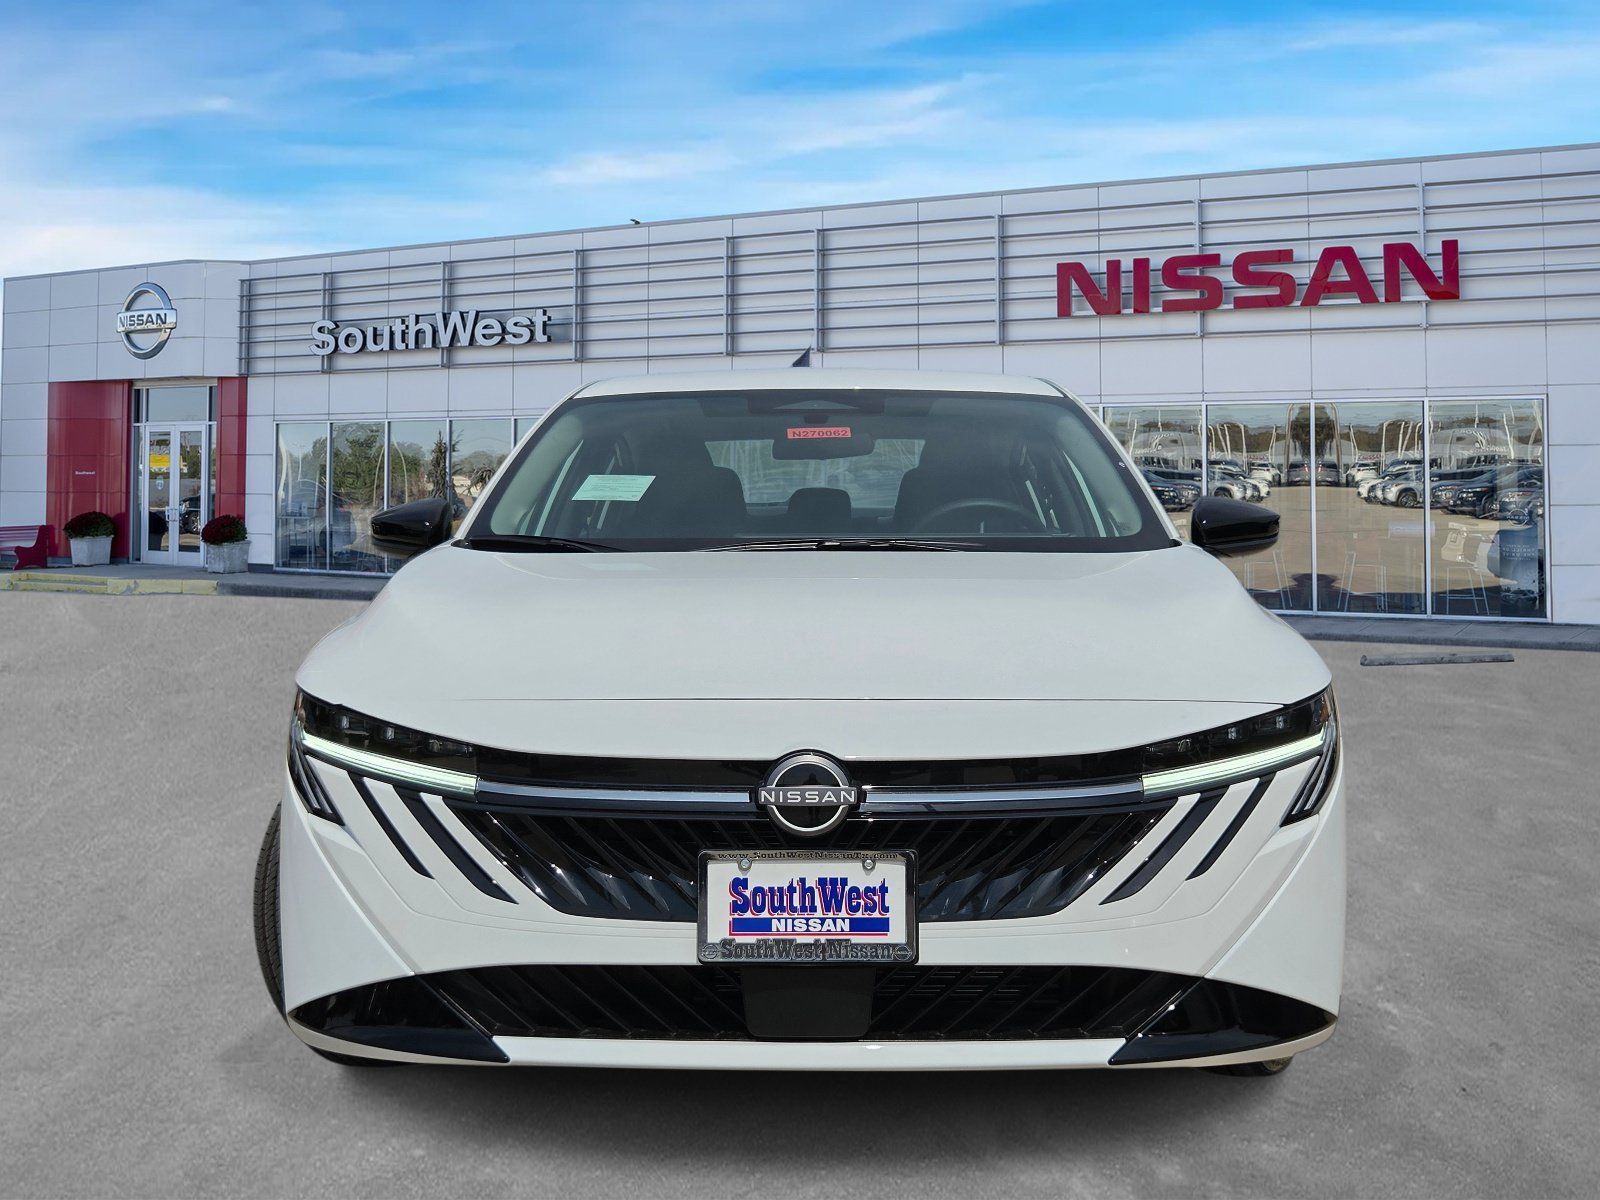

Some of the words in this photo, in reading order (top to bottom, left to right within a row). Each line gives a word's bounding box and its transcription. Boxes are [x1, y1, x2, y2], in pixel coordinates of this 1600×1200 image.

[1056, 239, 1460, 317] NISSAN
[119, 312, 167, 328] NISSAN
[308, 308, 551, 356] SouthWest
[792, 429, 849, 438] N270062
[760, 790, 855, 803] NISSAN
[728, 877, 890, 916] SouthWest
[771, 918, 850, 932] NISSAN
